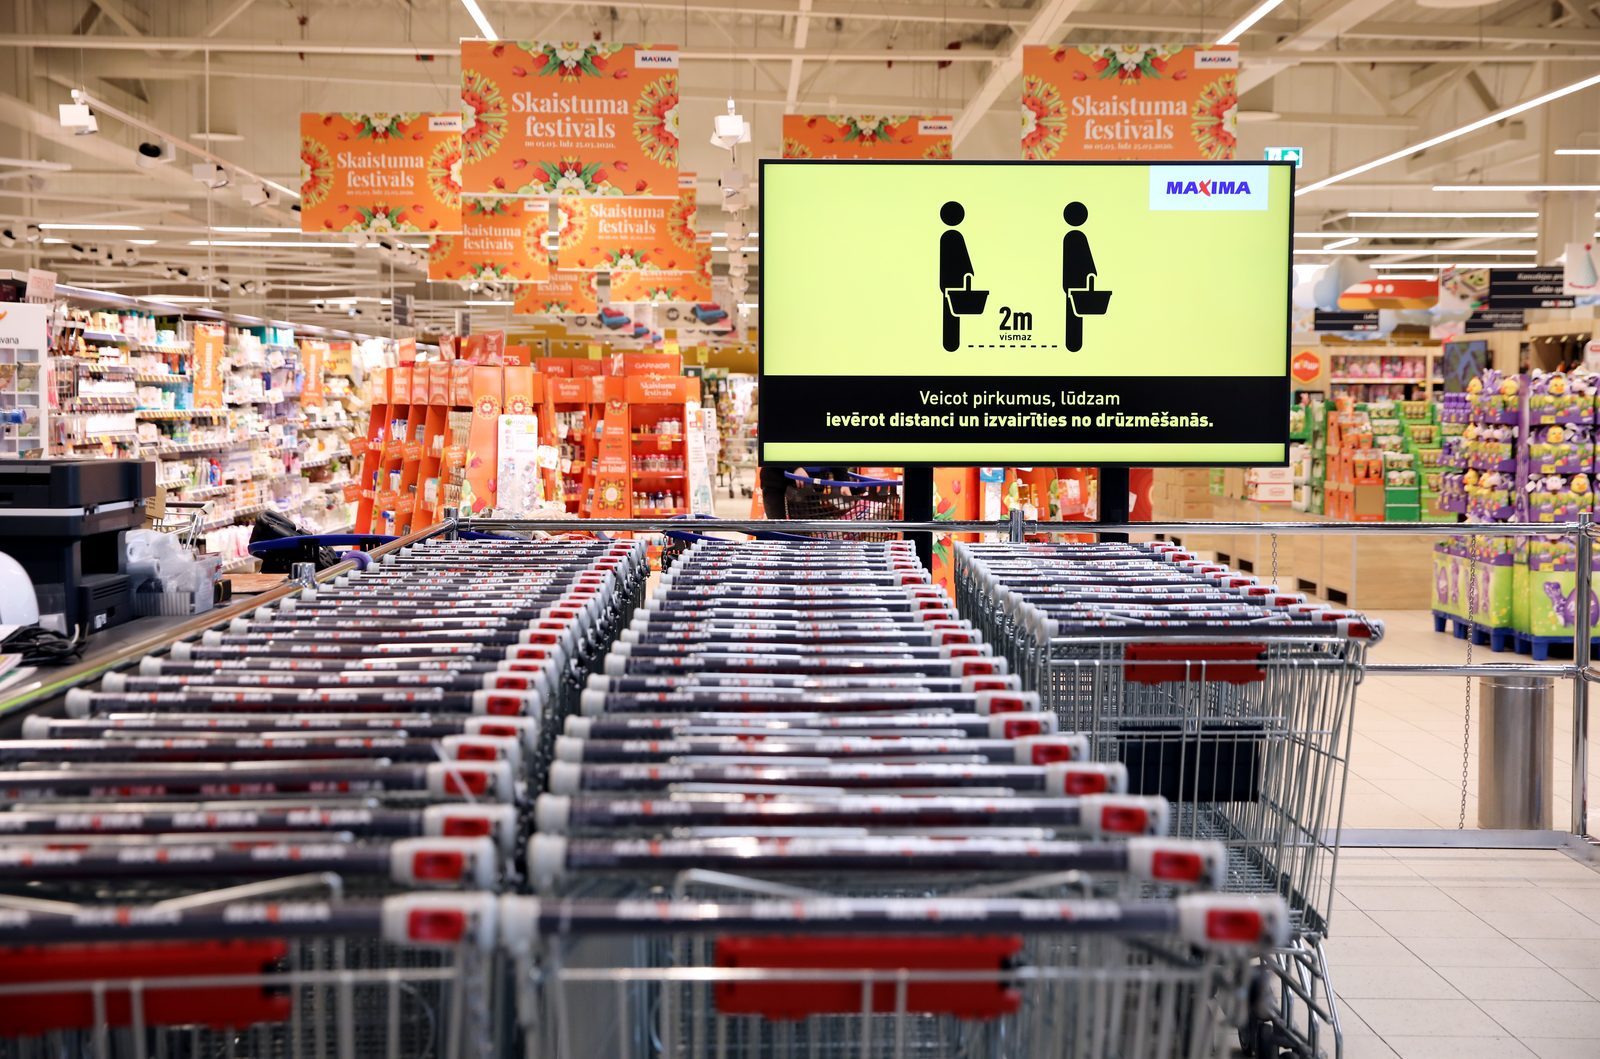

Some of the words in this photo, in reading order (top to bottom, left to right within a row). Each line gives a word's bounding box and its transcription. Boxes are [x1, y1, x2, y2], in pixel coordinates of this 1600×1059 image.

[512, 92, 629, 114] Skaistuma
[1072, 96, 1188, 116] Skaistuma
[525, 116, 616, 139] festivāls
[1084, 118, 1174, 140] festivāls
[336, 152, 424, 168] Skaistuma
[1166, 179, 1251, 198] MAXIMA
[590, 204, 664, 218] Skaistuma
[464, 224, 522, 236] kaistuma
[999, 306, 1033, 331] 2m
[999, 333, 1032, 342] vismaz
[919, 390, 968, 406] Veicot
[972, 391, 1056, 409] pirkumus,
[1061, 390, 1120, 406] lūdzam
[826, 412, 886, 428] ievērot
[889, 412, 954, 428] distanci
[958, 416, 980, 428] un
[984, 412, 1068, 428] izvairīties
[1072, 416, 1092, 428] no
[1096, 412, 1214, 428] drūzmēšanās.
